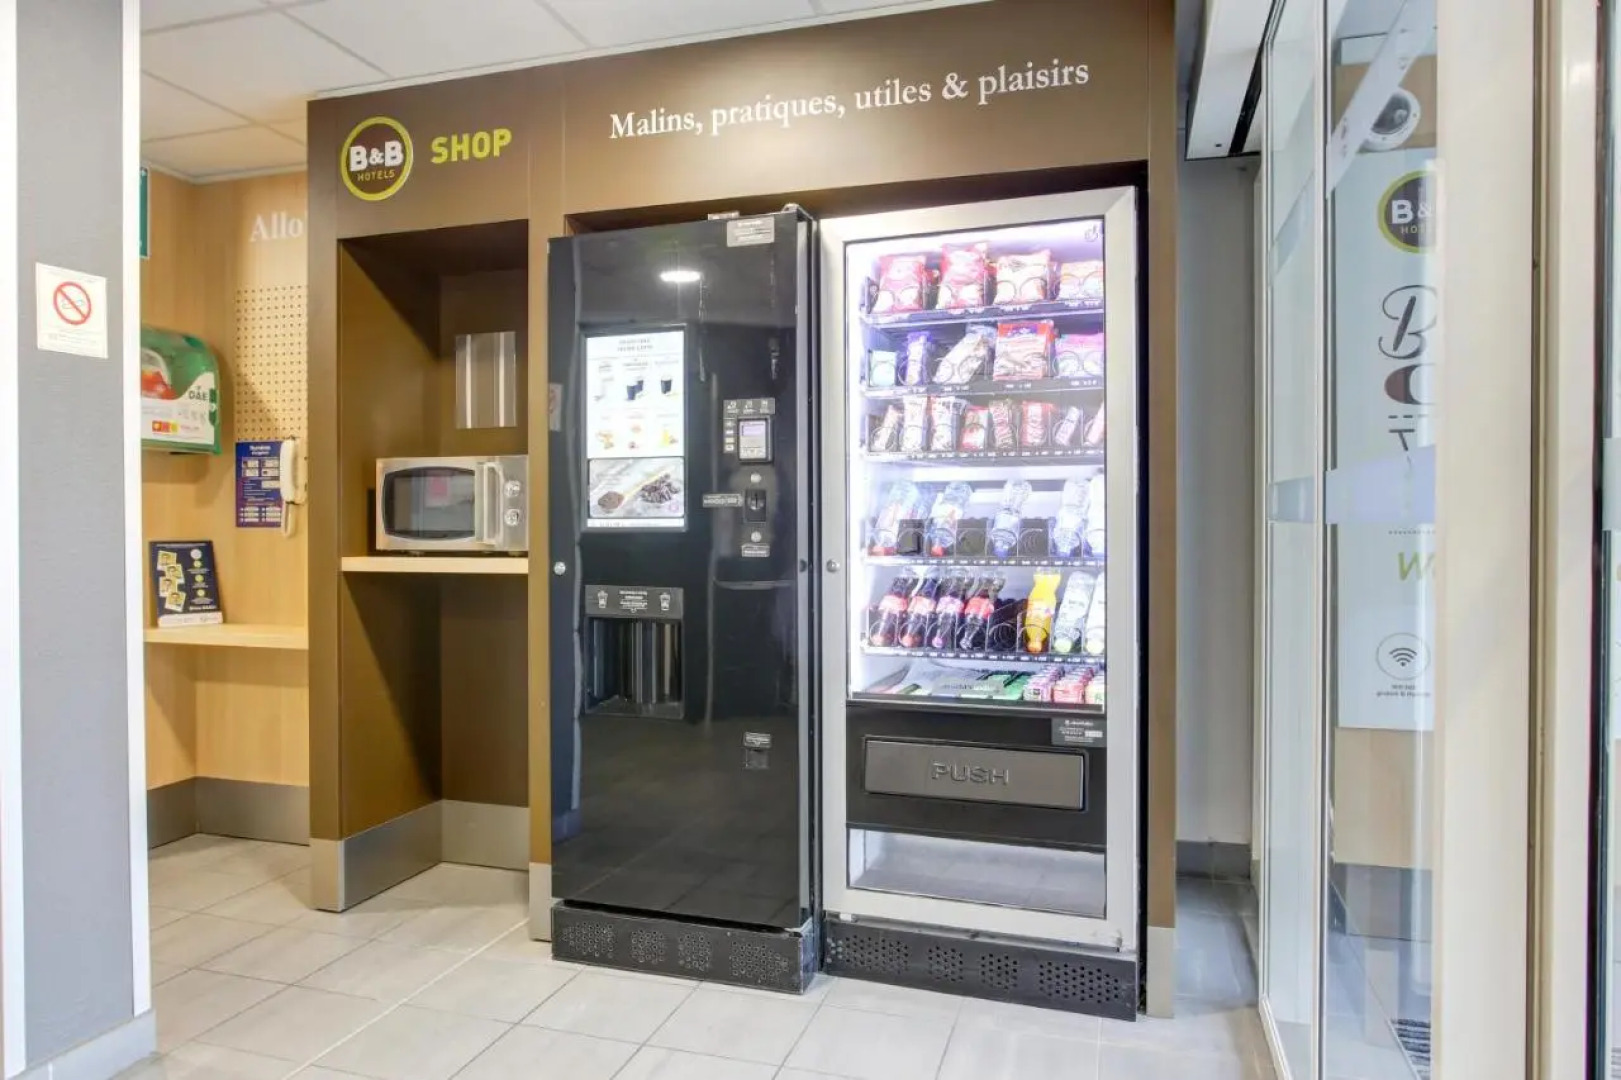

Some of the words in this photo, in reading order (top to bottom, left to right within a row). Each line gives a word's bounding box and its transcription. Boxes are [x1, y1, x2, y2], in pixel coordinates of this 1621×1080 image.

[609, 107, 702, 139] Malins,
[711, 93, 846, 137] pratiques,
[854, 79, 932, 108] utiles
[941, 72, 969, 100] &
[977, 58, 1090, 105] plaisirs
[350, 140, 404, 172] B&B
[431, 128, 513, 165] SHOP
[356, 169, 396, 182] HOTELS
[250, 210, 304, 242] Allo
[931, 760, 1009, 786] PUSH
